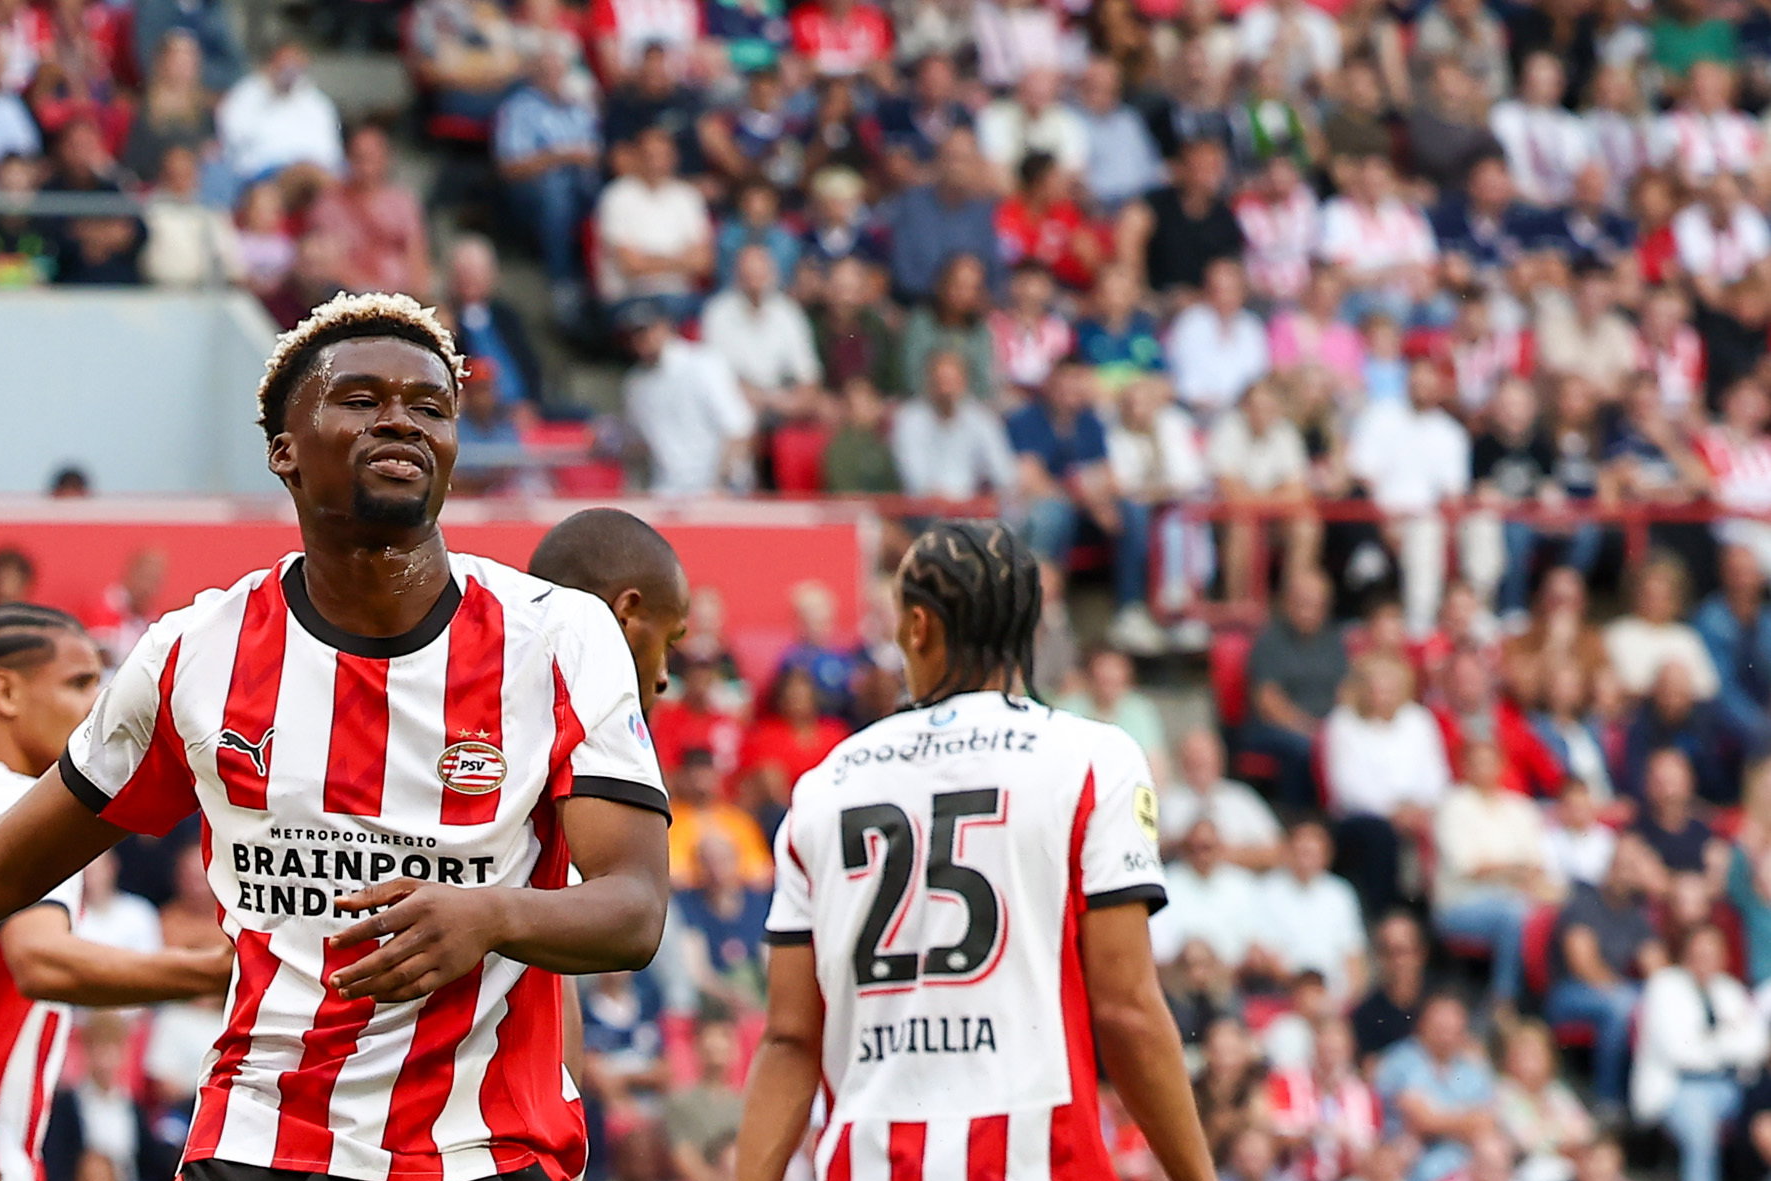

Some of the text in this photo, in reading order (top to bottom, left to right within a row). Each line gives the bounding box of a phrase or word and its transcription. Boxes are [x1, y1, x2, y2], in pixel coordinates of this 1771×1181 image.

[460, 760, 486, 772] PSV
[270, 827, 438, 849] METROPOOLREGIO
[232, 842, 495, 885] BRAINPORT
[237, 880, 390, 920] EINDH
[840, 787, 1008, 998] 25
